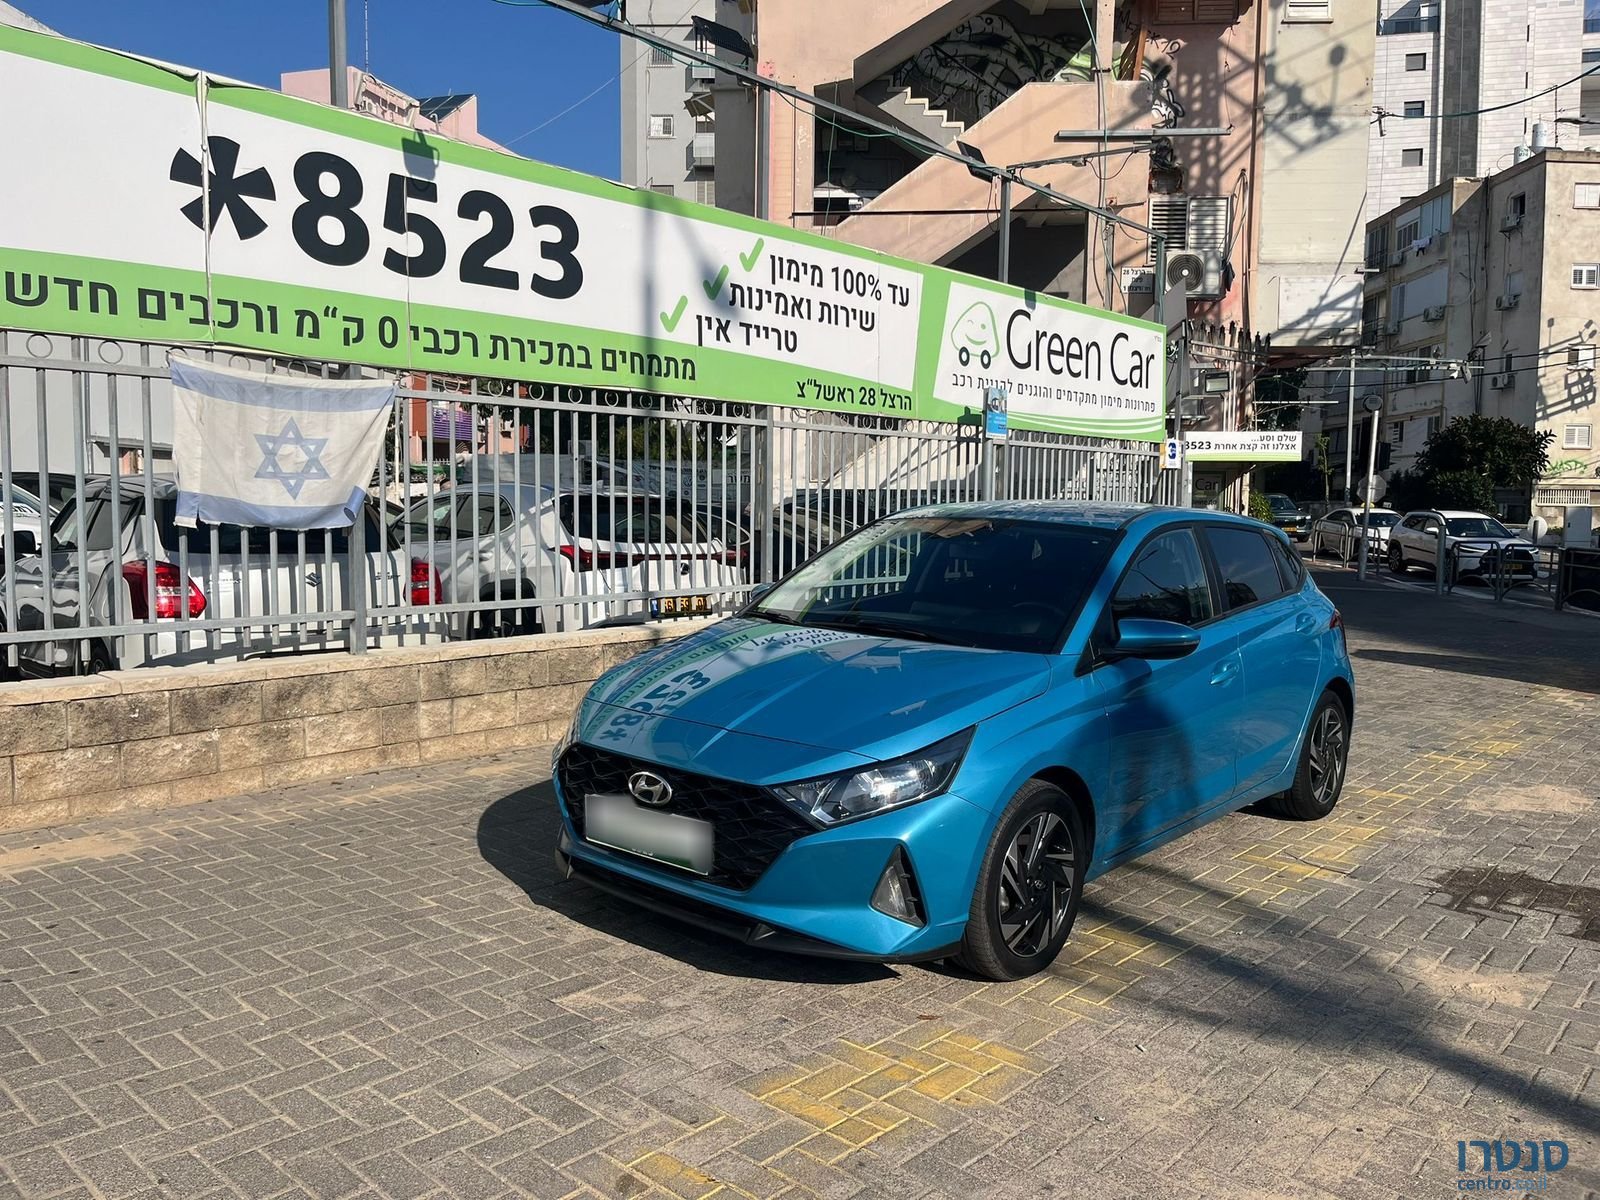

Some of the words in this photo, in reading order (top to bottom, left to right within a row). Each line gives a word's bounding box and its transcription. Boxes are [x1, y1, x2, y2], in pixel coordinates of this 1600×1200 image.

[770, 254, 824, 287] מימון
[832, 267, 882, 301] 100%
[729, 283, 812, 320] ואמינות
[888, 283, 910, 307] עד
[138, 288, 279, 334] ורכבים
[818, 301, 875, 331] שירות
[378, 316, 399, 349] 0
[410, 326, 479, 357] רכבי
[696, 314, 731, 346] אין
[739, 321, 798, 352] טרייד
[490, 335, 592, 370] במכירת
[1006, 309, 1101, 381] Green
[1110, 332, 1155, 389] Car
[601, 348, 697, 381] מתמחים
[952, 373, 973, 388] רכב
[1017, 383, 1052, 399] והוגנים
[859, 386, 876, 406] 28
[880, 388, 912, 411] הרצל
[1056, 390, 1097, 406] מתקדמים
[1101, 394, 1122, 409] מימון
[1125, 398, 1156, 413] פתרונות
[1214, 442, 1238, 450] אחרת
[1240, 442, 1258, 452] קצת
[1272, 442, 1297, 450] אצלנו
[1277, 434, 1297, 442] שלם
